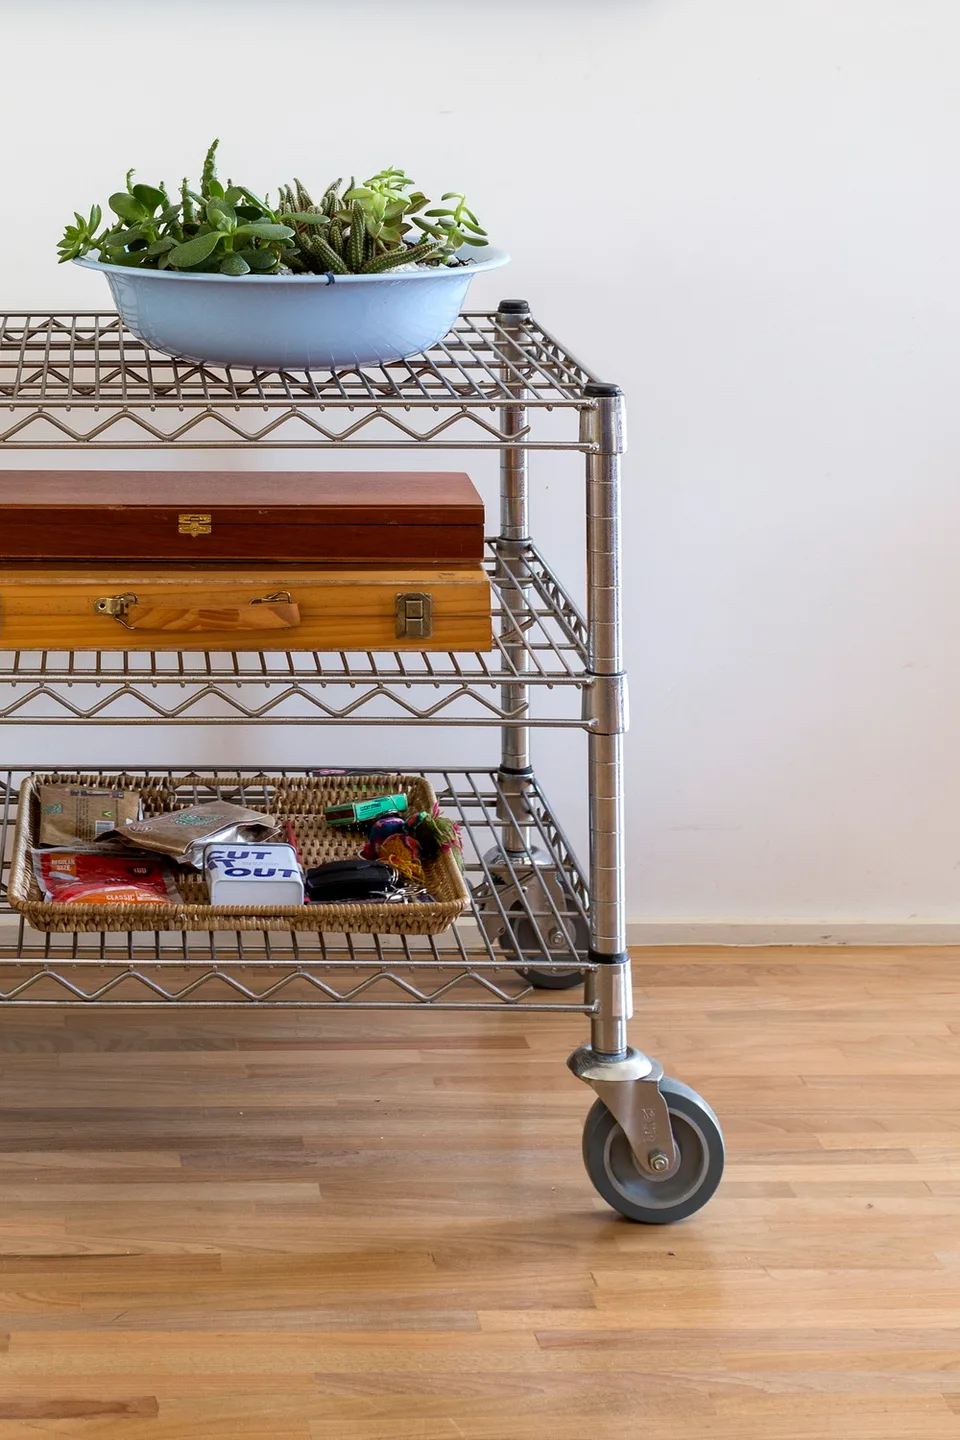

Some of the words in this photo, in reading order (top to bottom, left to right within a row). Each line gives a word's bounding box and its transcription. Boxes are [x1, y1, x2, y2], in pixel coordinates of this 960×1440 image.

[207, 850, 272, 861] CUT
[224, 867, 299, 878] OUT
[106, 894, 135, 902] CLASSIC
